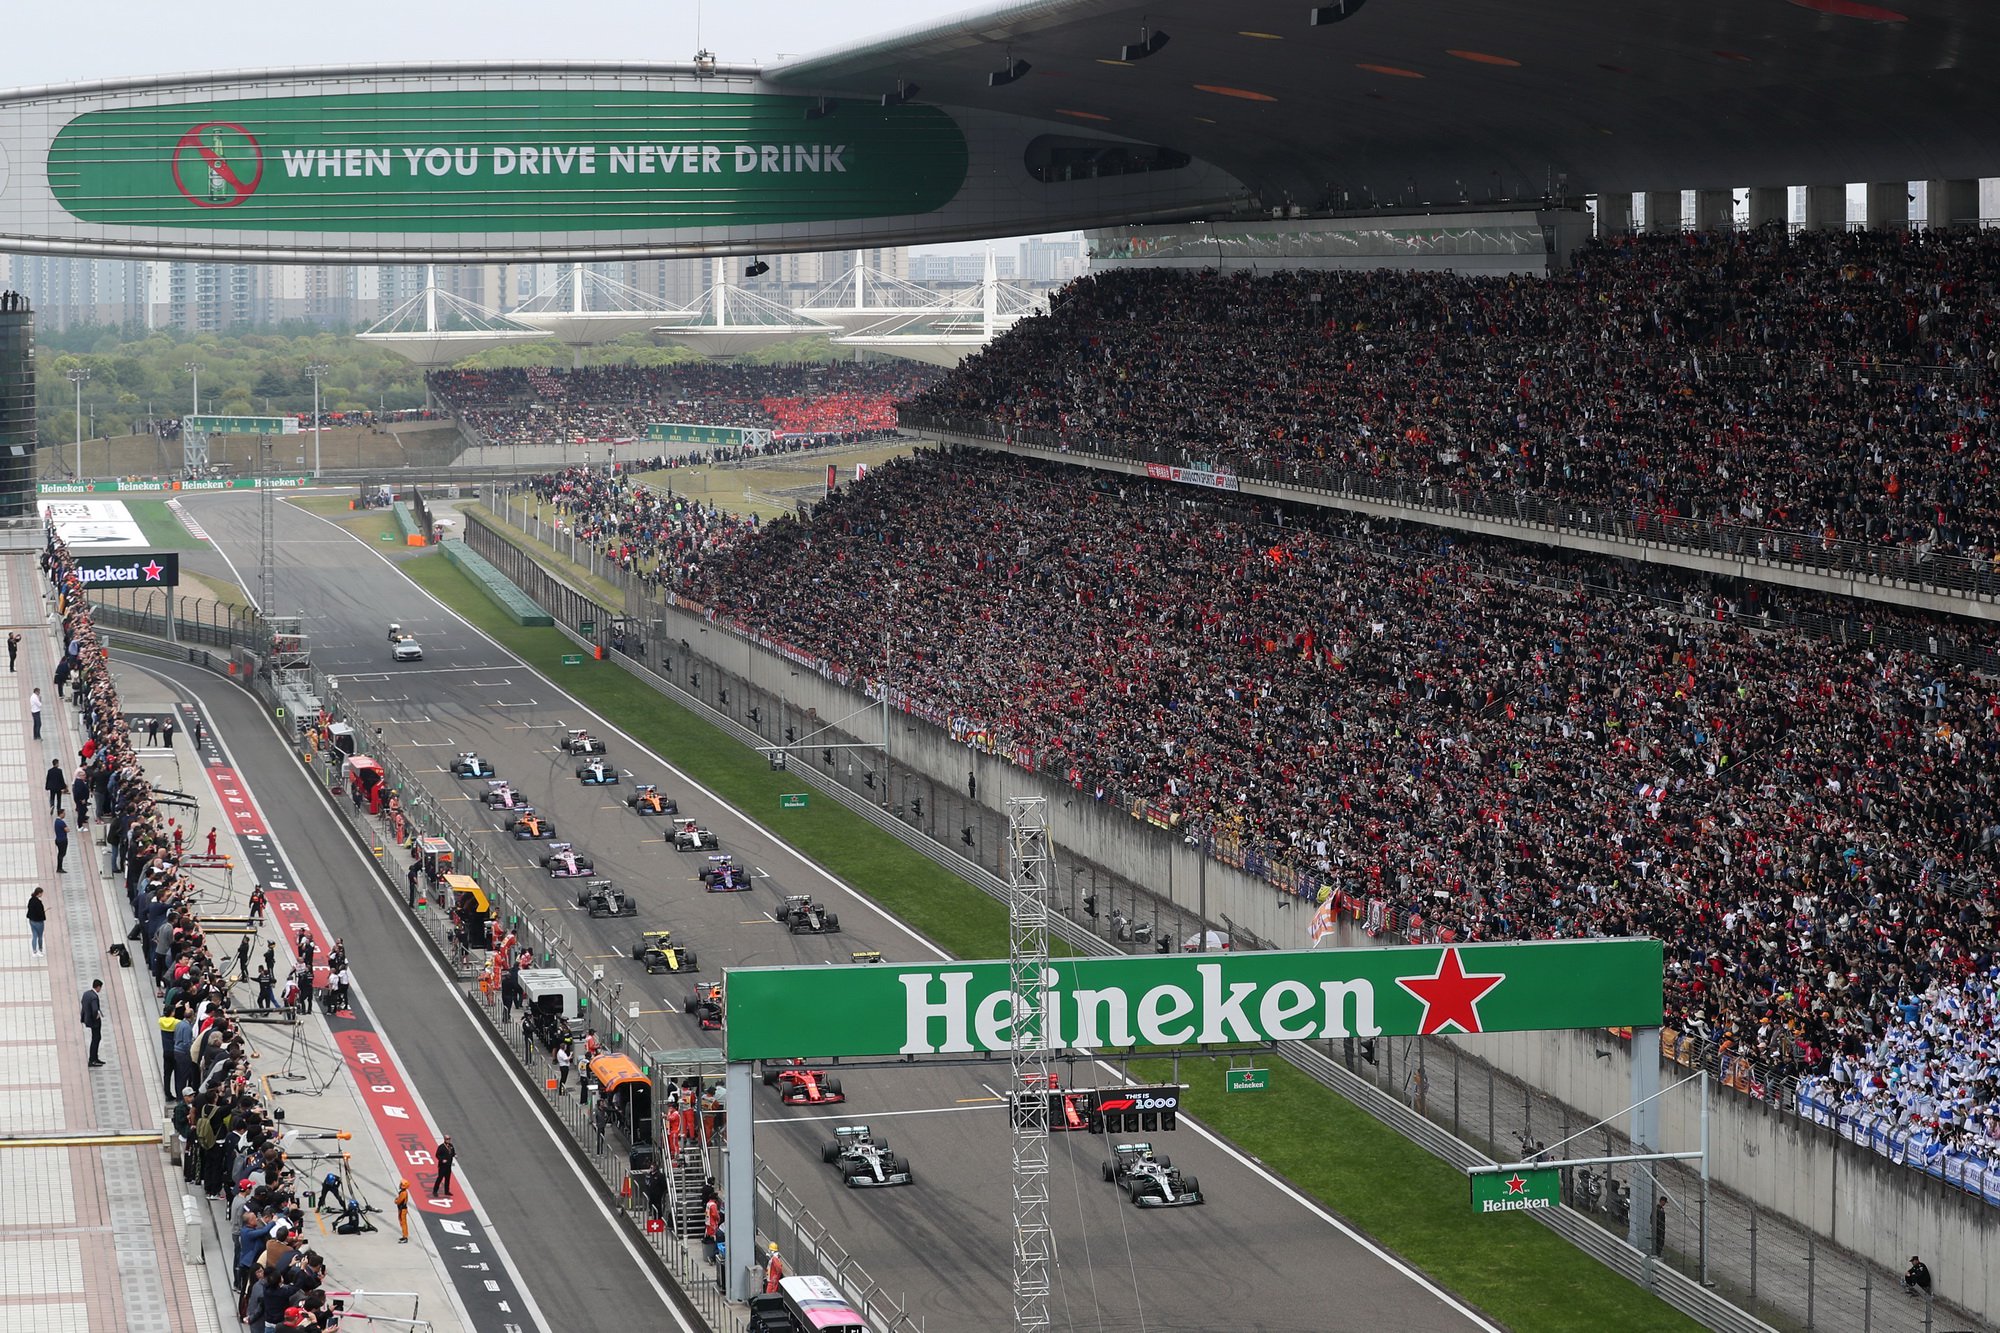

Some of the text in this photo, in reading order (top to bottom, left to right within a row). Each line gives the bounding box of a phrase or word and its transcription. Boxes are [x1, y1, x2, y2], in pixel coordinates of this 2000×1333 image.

[282, 144, 847, 178] WHEN YOU DRIVE NEVER DRINK
[41, 483, 84, 493] Heineken
[118, 482, 160, 491] Heineken
[182, 480, 223, 490] Heineken
[898, 963, 1383, 1054] Heineken
[357, 1052, 381, 1065] 20
[371, 1085, 396, 1094] 8
[1233, 1082, 1264, 1090] Heineken
[1135, 1097, 1177, 1110] 1000
[404, 1149, 435, 1165] 55
[428, 1198, 454, 1209] 4
[1482, 1197, 1550, 1213] Heineken
